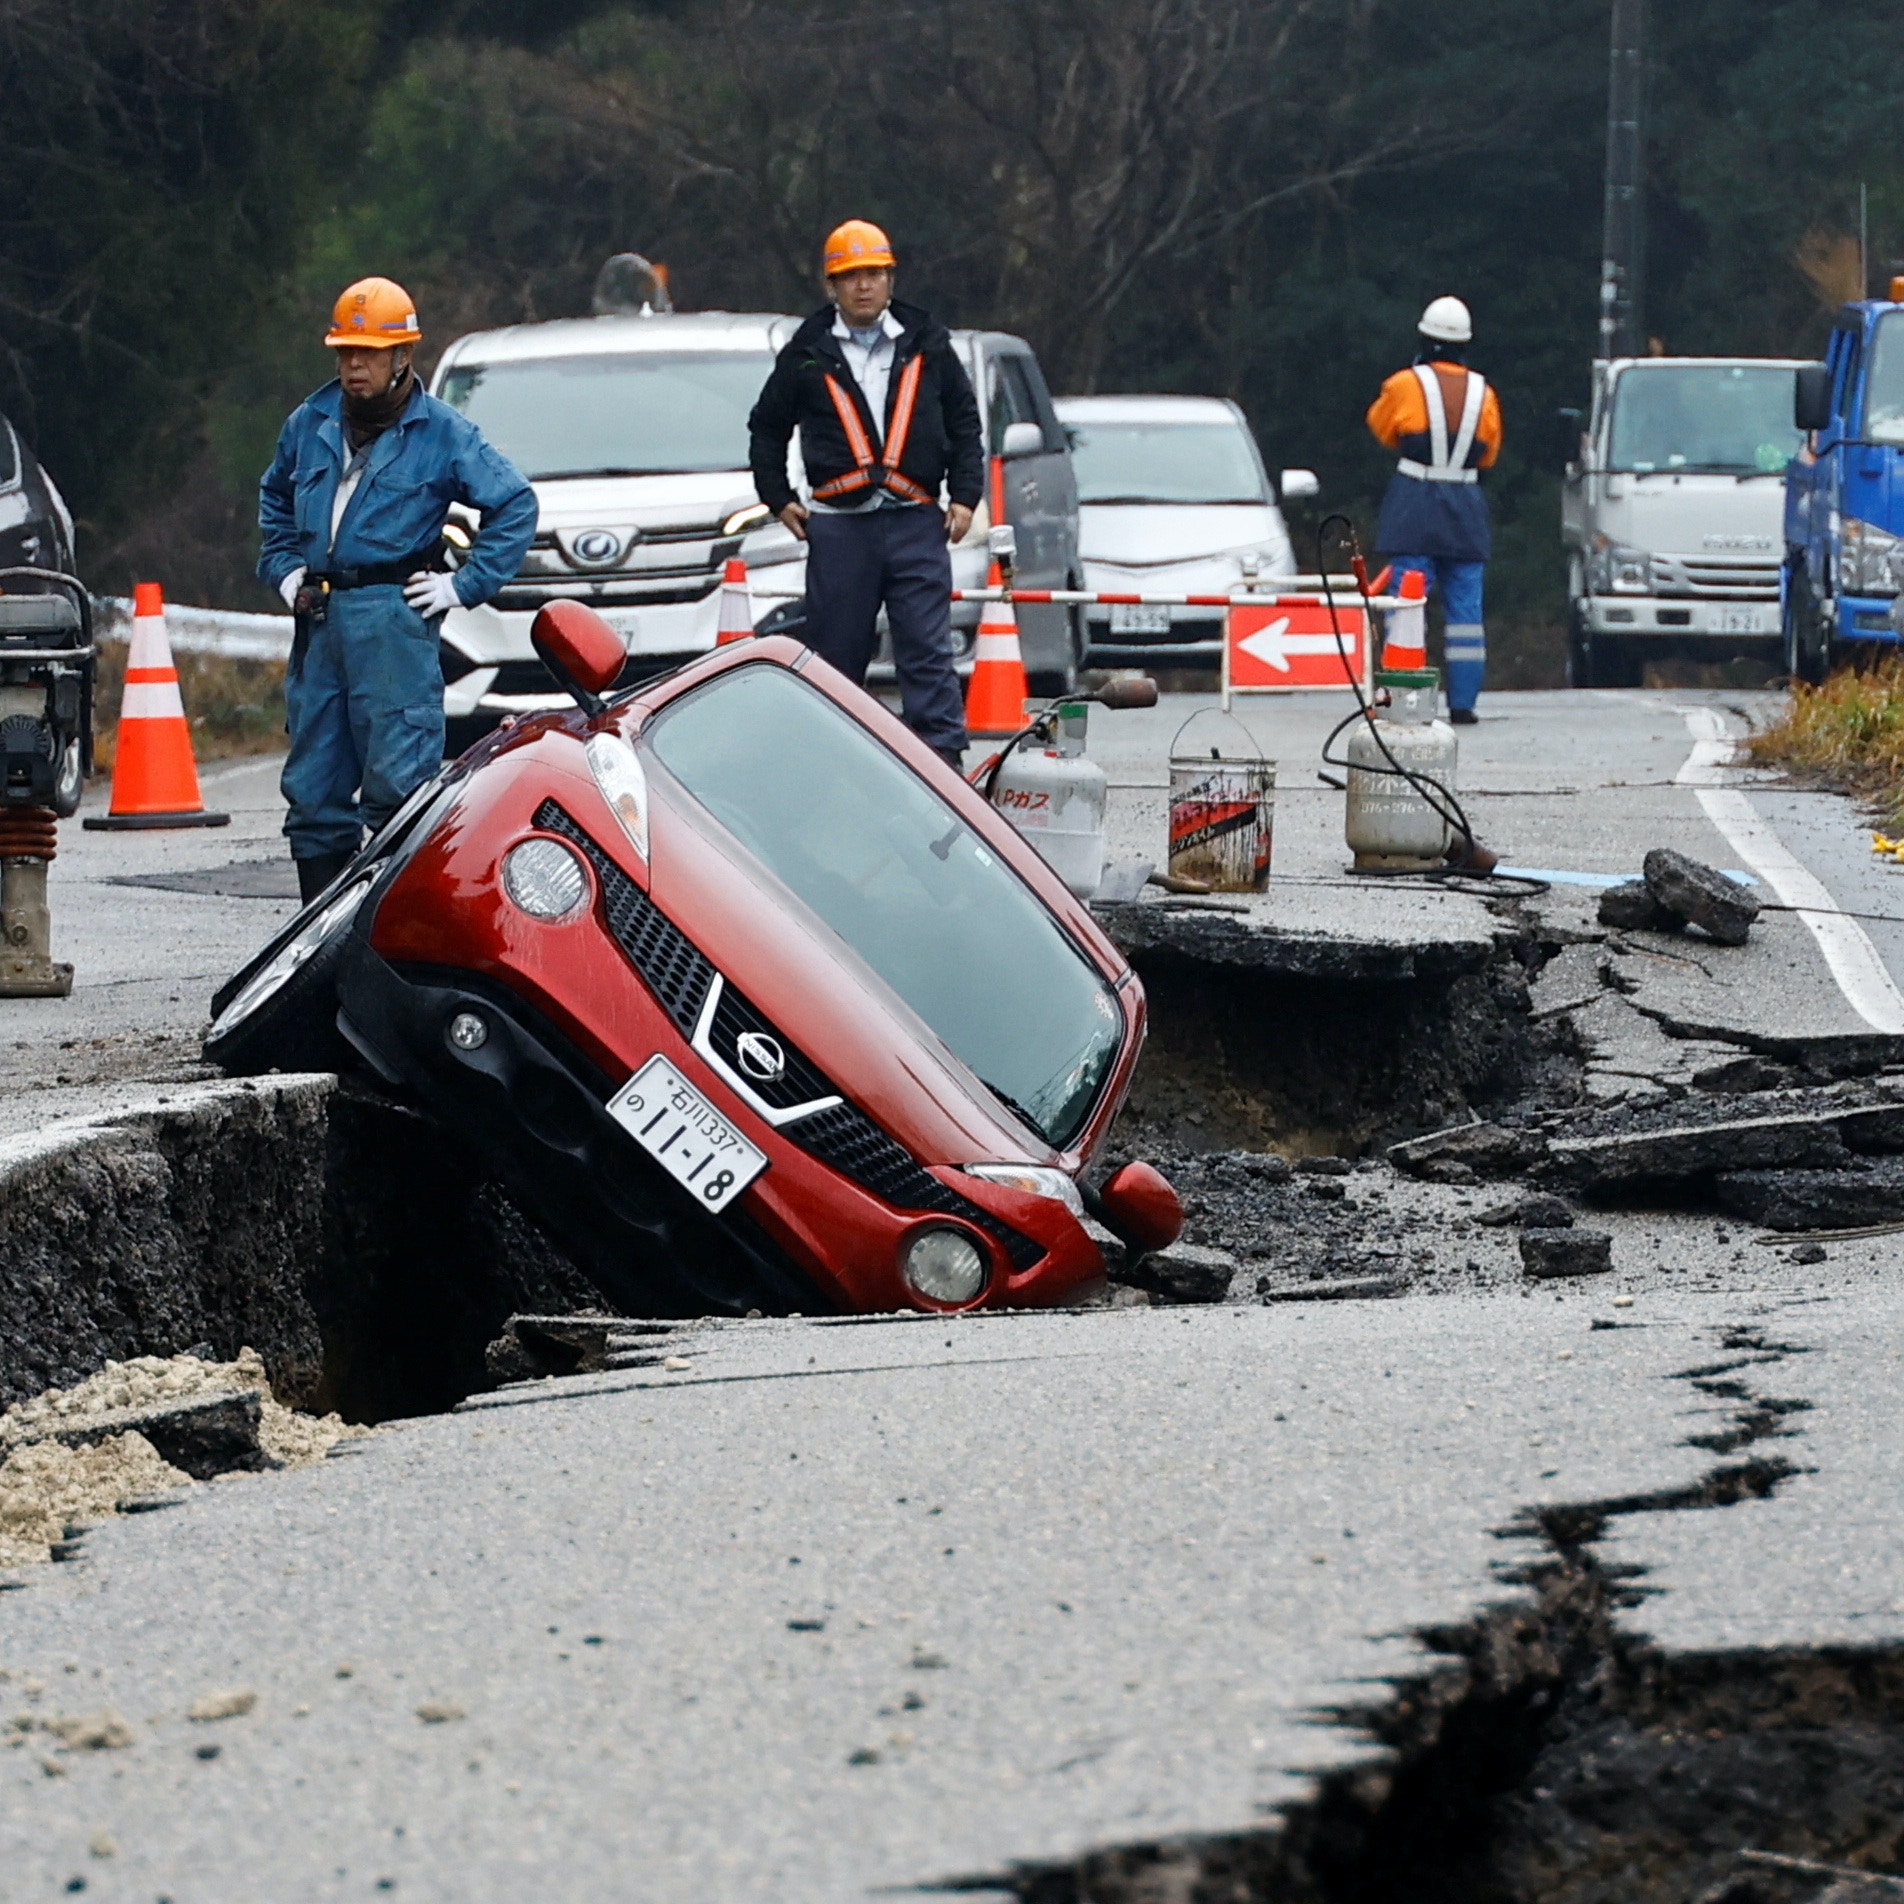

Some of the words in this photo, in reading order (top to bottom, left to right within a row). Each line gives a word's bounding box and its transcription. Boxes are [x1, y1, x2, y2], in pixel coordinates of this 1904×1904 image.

[626, 1093, 645, 1113] の
[639, 1106, 736, 1202] 11-18
[670, 1085, 739, 1152] 石川337
